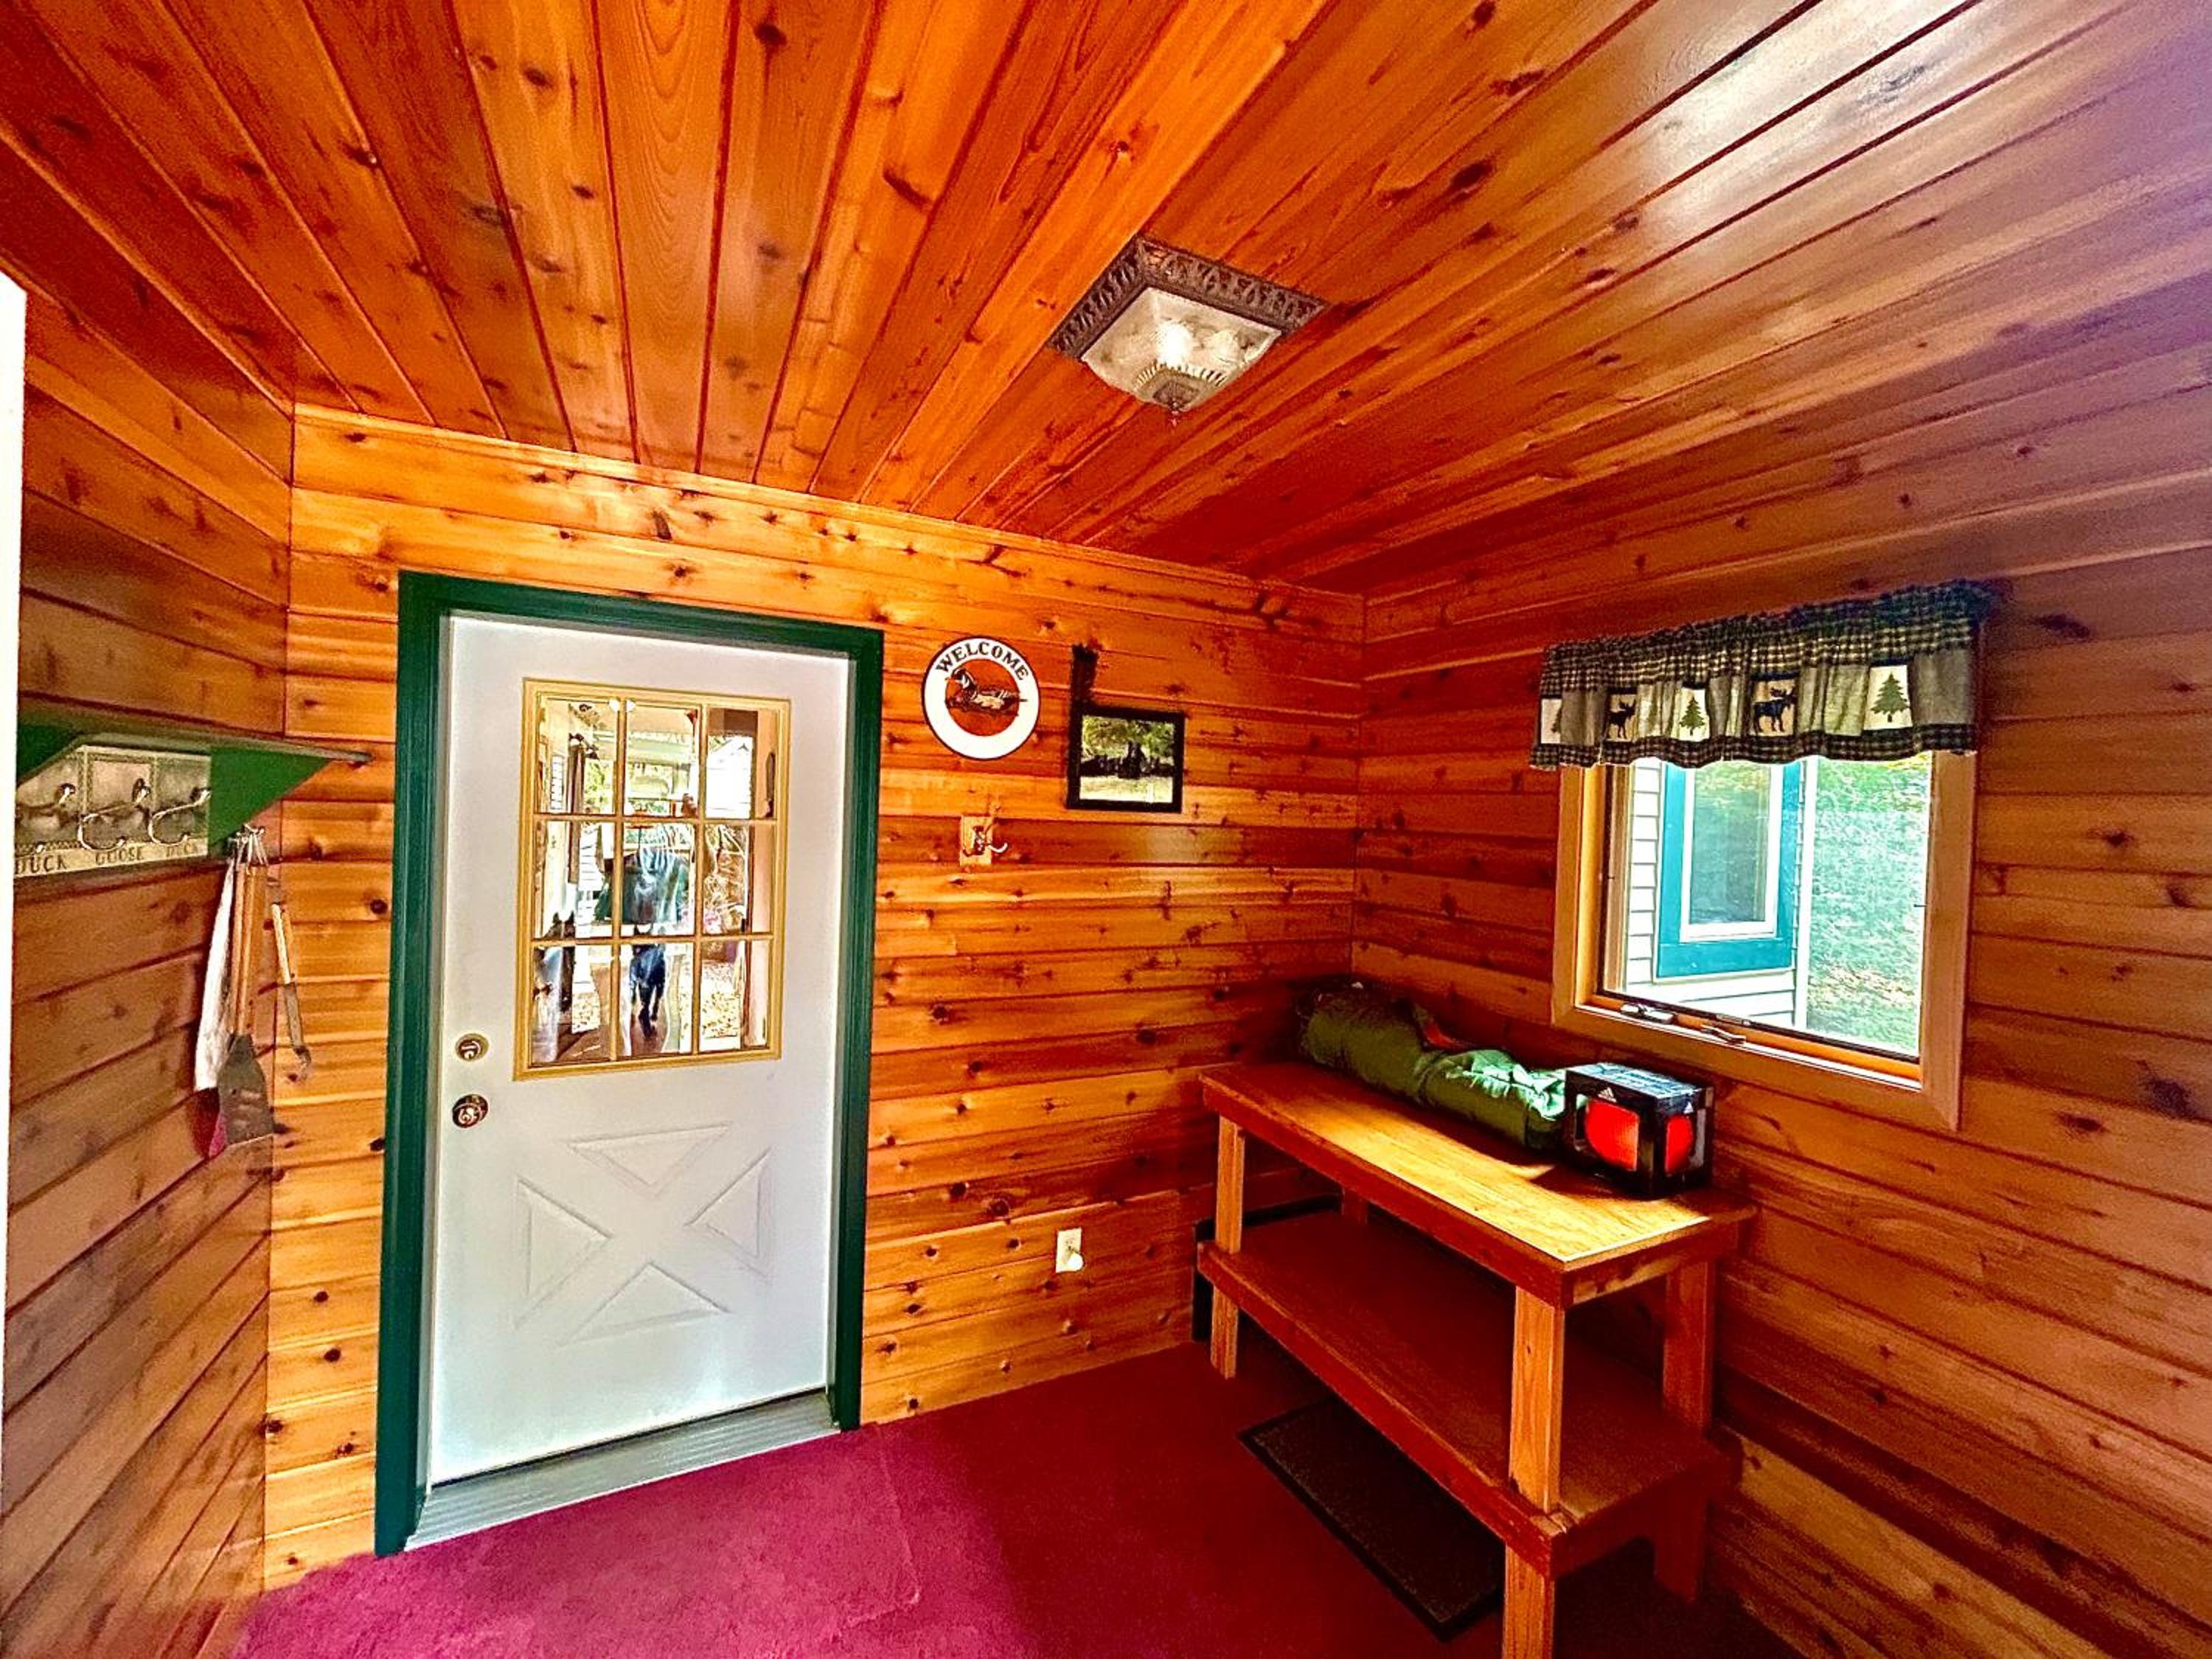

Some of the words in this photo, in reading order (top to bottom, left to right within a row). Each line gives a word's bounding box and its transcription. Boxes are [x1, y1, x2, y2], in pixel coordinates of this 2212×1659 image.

[935, 641, 1029, 681] WELCOME
[15, 855, 67, 874] DUCK
[95, 846, 144, 866] GOOSE
